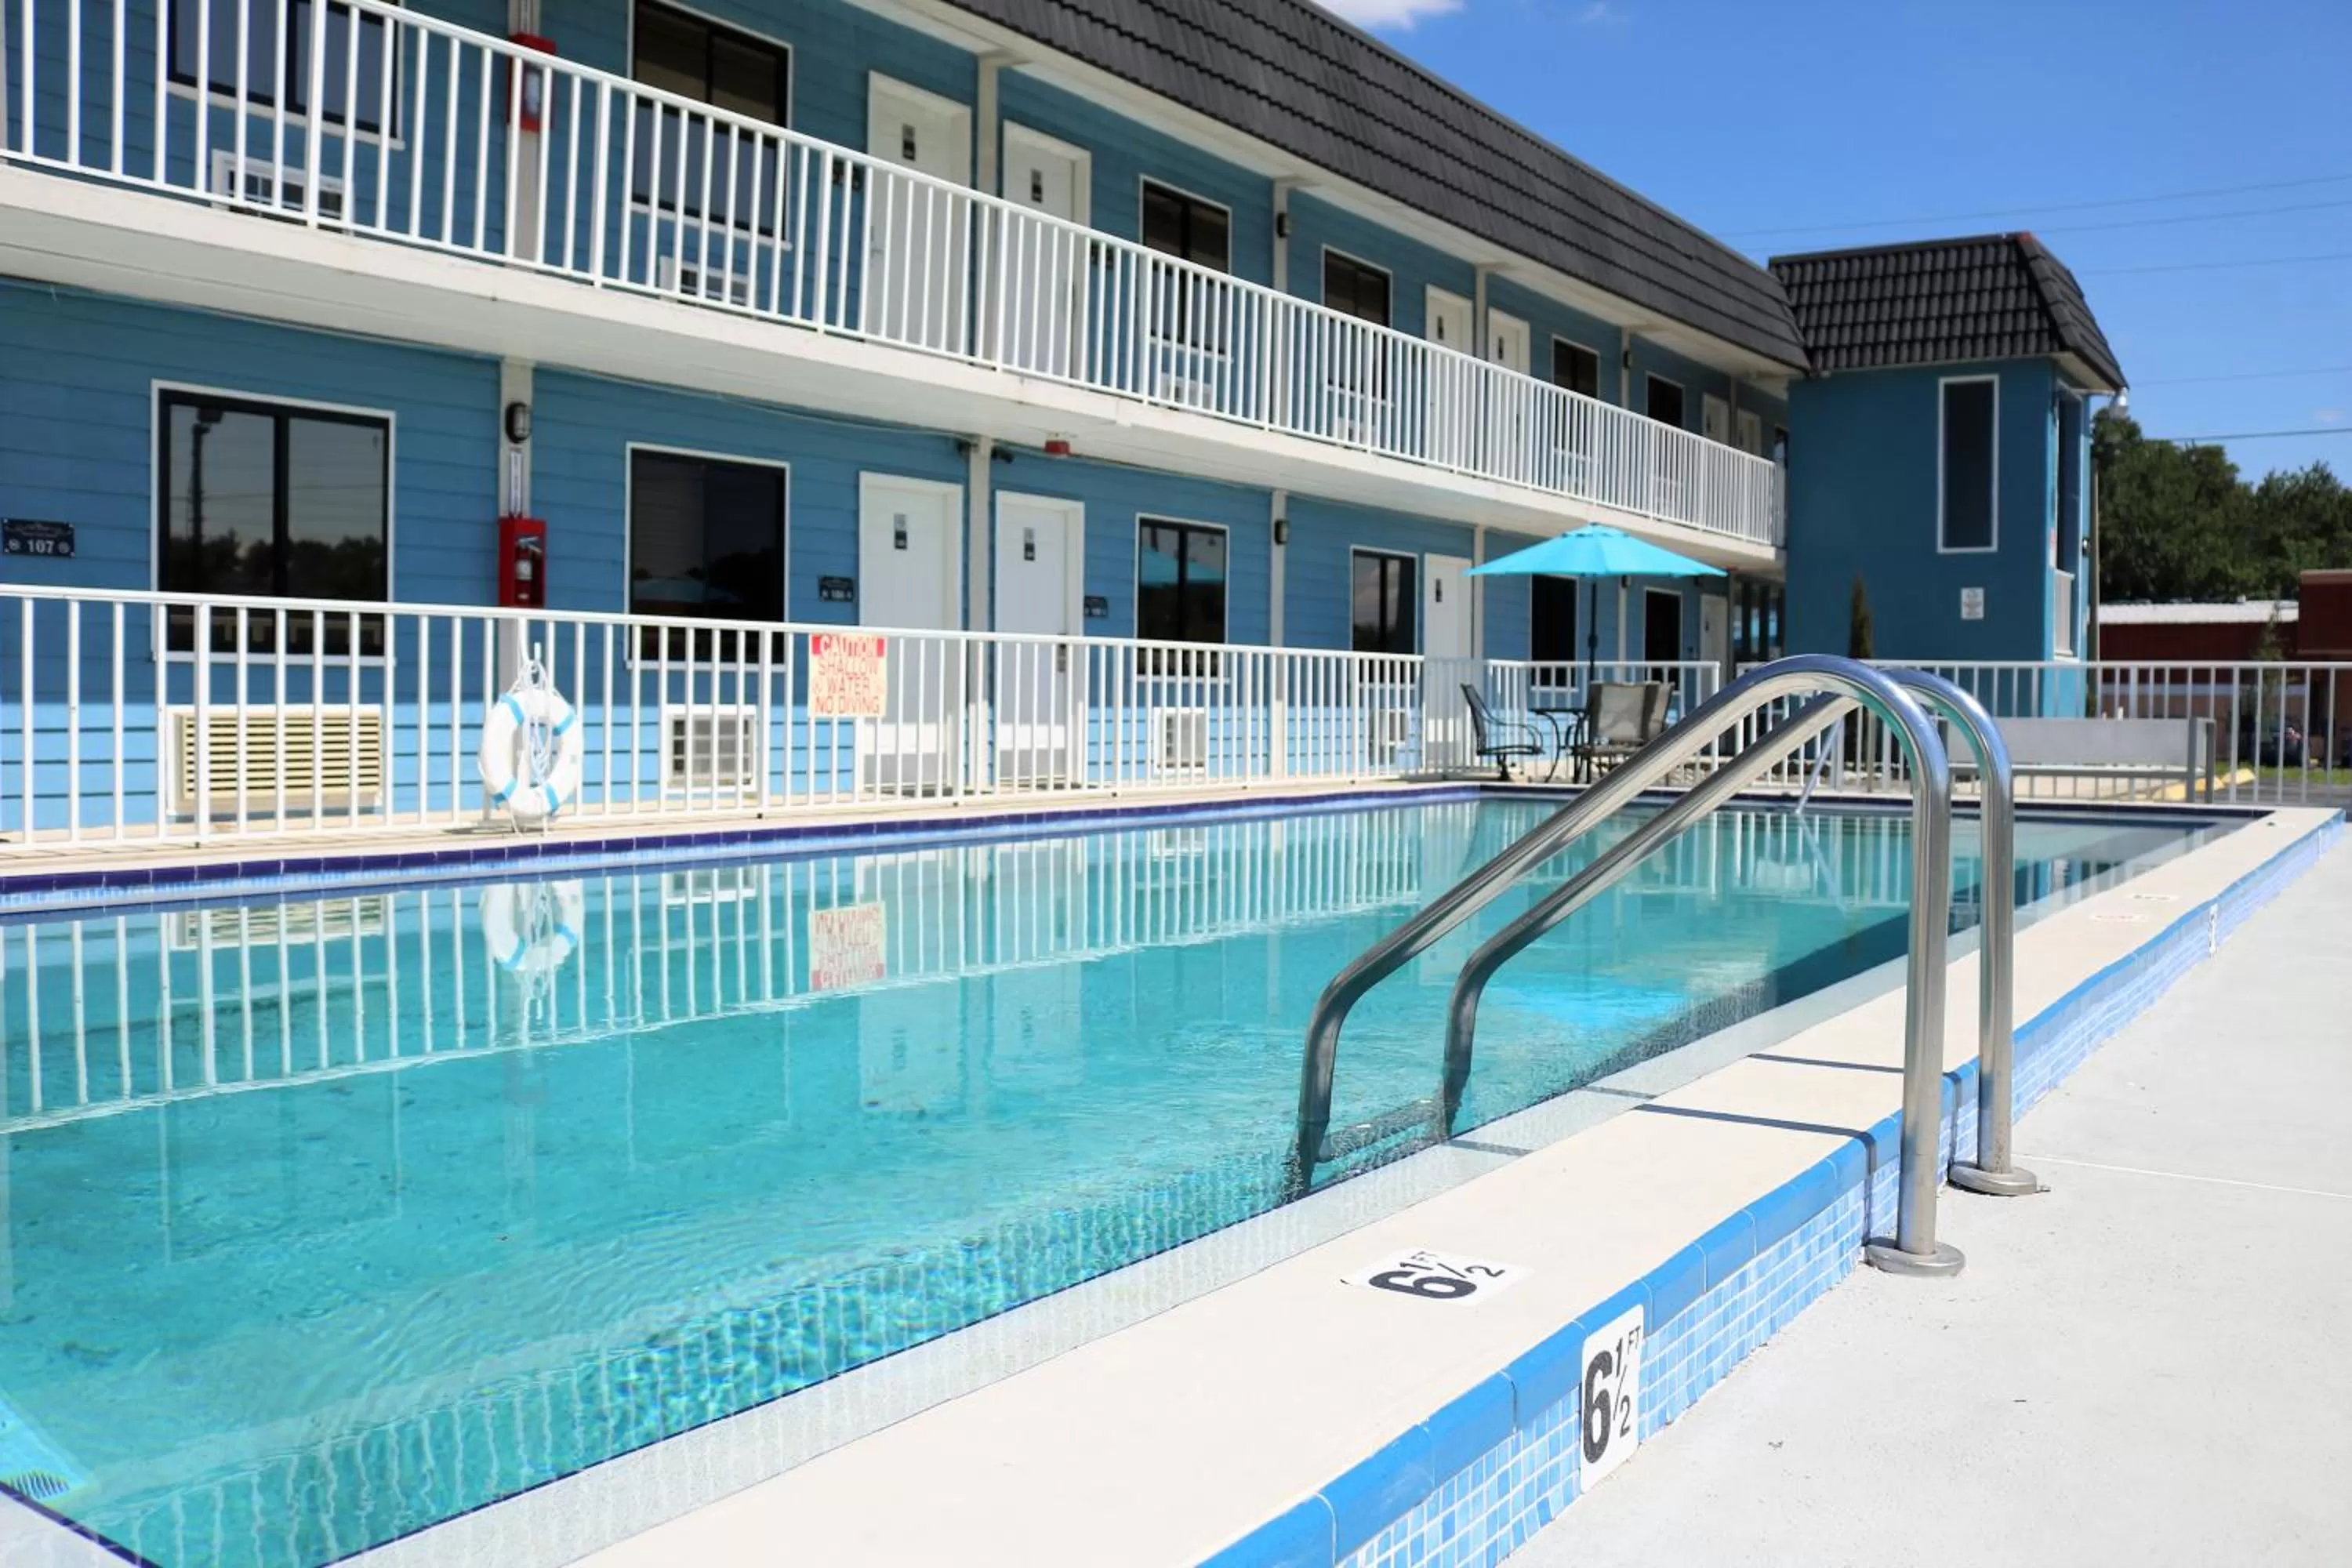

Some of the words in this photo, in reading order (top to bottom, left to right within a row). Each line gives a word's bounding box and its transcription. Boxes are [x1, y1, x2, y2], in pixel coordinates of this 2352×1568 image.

[27, 539, 55, 554] 107
[820, 634, 877, 657] CAUTION
[818, 657, 878, 675] SHALLOW
[827, 677, 870, 695] WATER
[815, 696, 834, 713] NO
[838, 696, 880, 714] DIVING
[1627, 1325, 1641, 1355] FT
